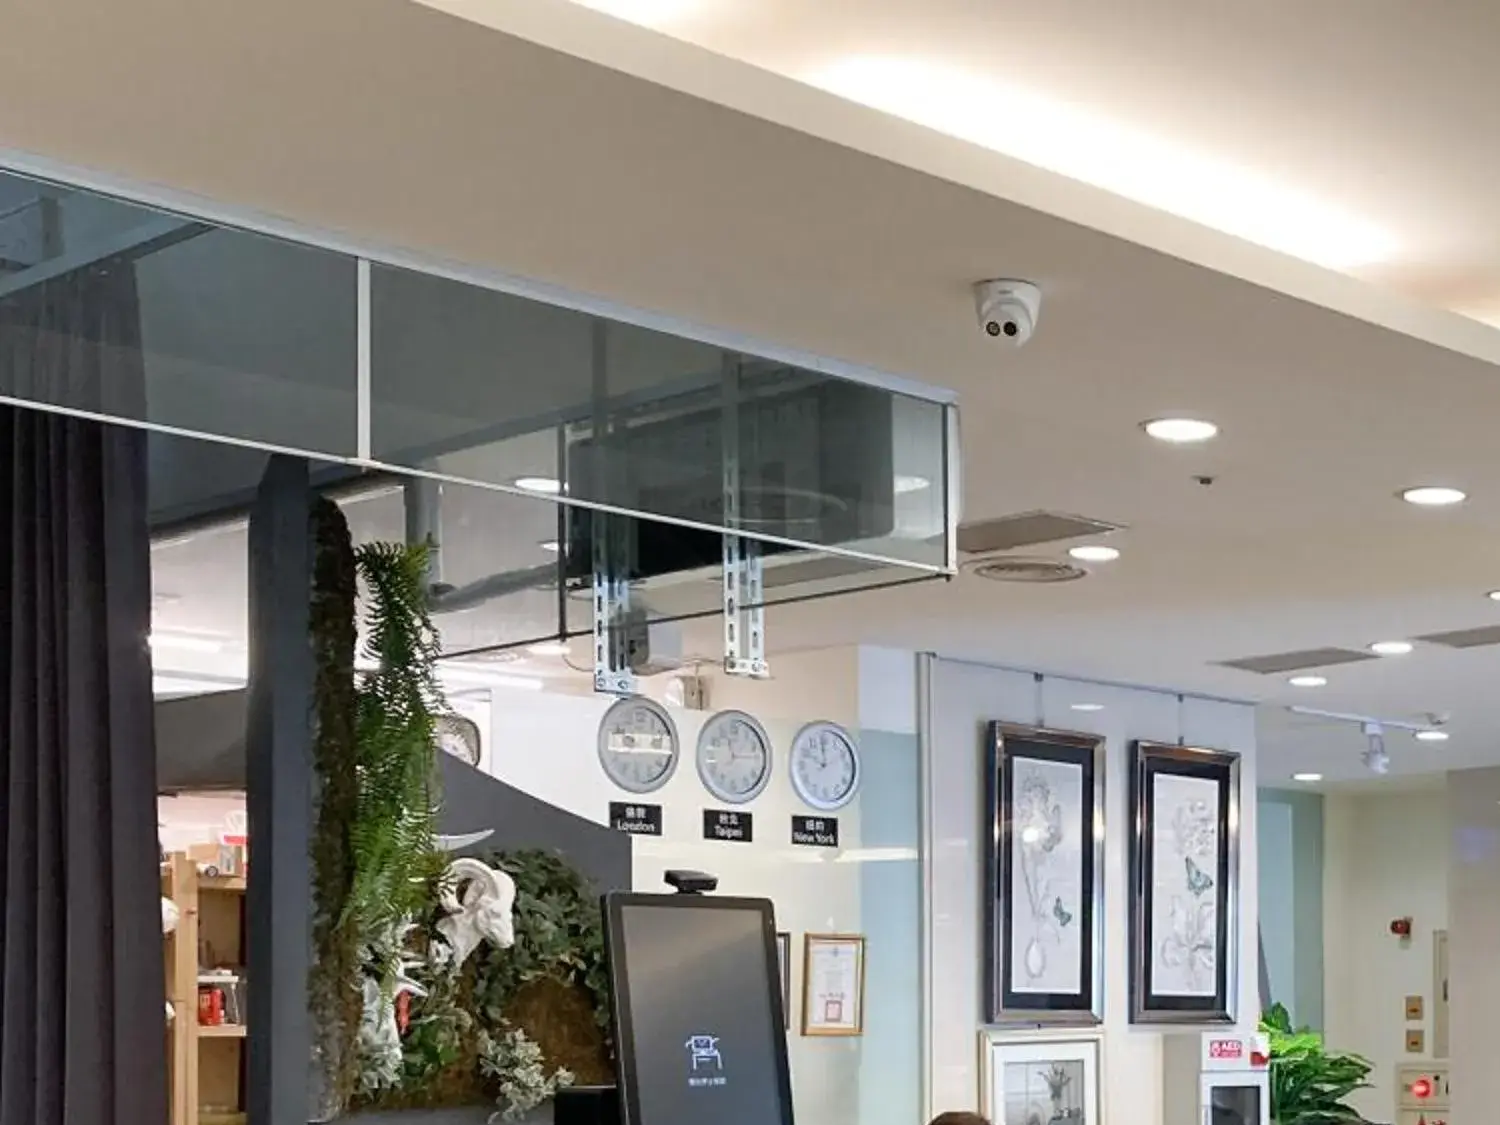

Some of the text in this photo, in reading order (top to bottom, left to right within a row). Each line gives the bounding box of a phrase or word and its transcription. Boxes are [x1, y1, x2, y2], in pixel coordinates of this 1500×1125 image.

[617, 819, 655, 832] London
[714, 824, 743, 839] Taipei
[793, 831, 835, 845] New York
